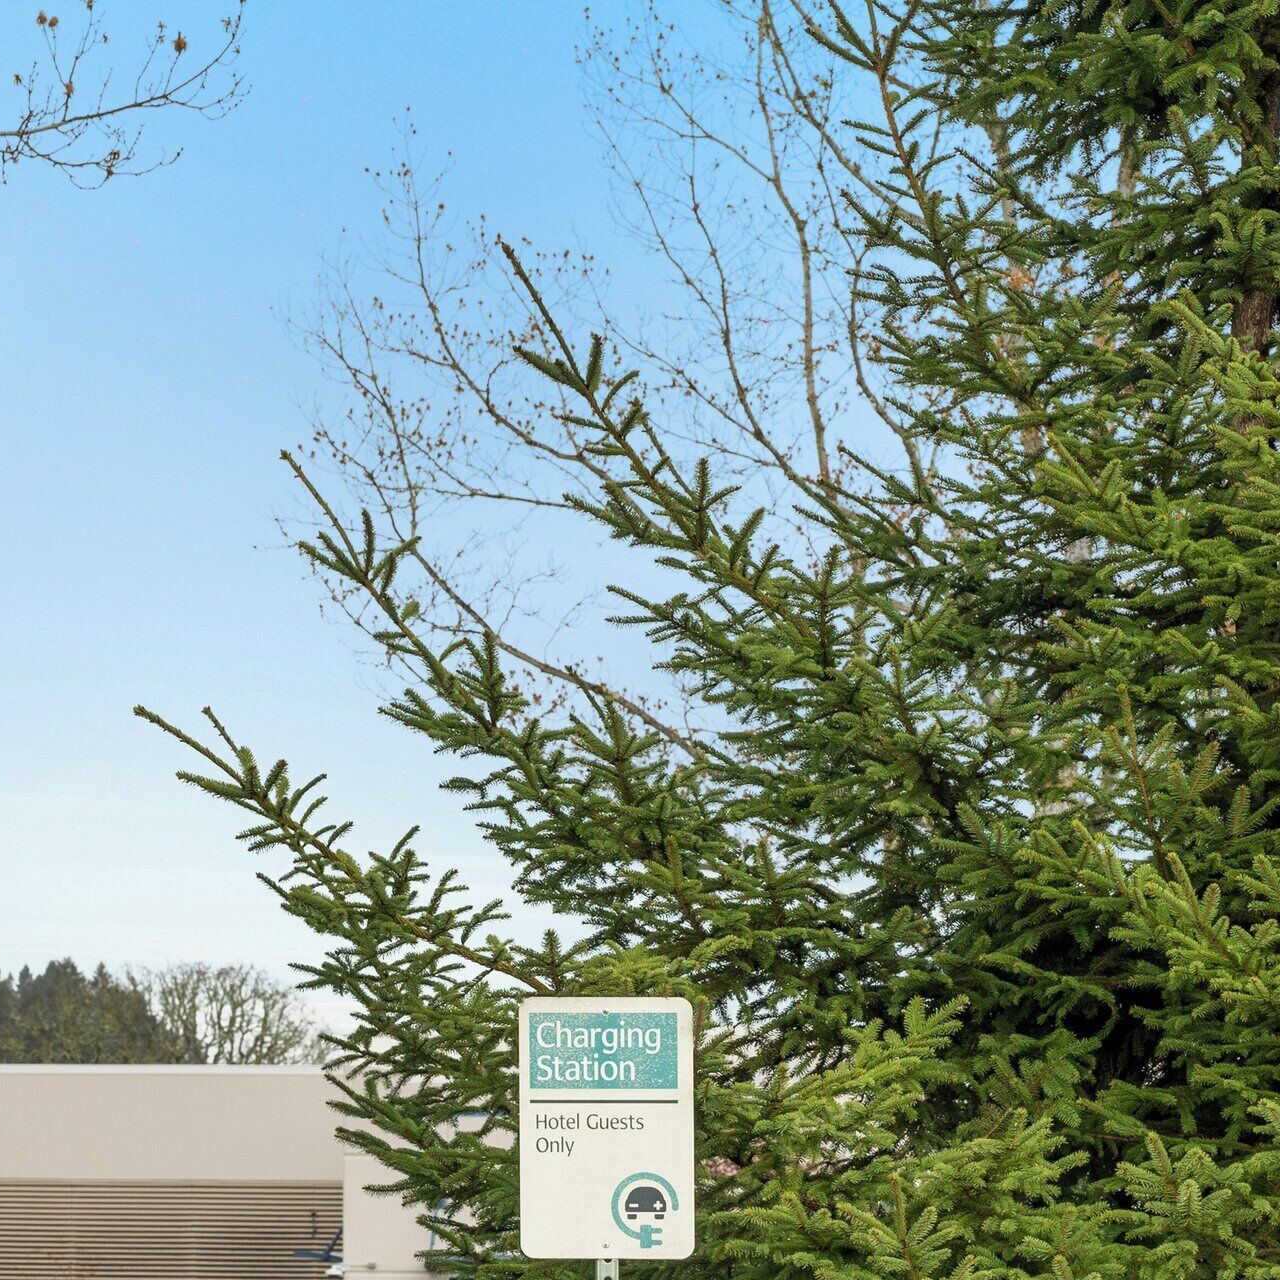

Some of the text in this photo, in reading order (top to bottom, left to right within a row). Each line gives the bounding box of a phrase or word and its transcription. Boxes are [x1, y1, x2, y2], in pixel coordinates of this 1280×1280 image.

[535, 1021, 661, 1053] Charging
[536, 1054, 637, 1081] Station
[535, 1113, 644, 1130] Hotel Guests
[535, 1137, 575, 1157] Only
